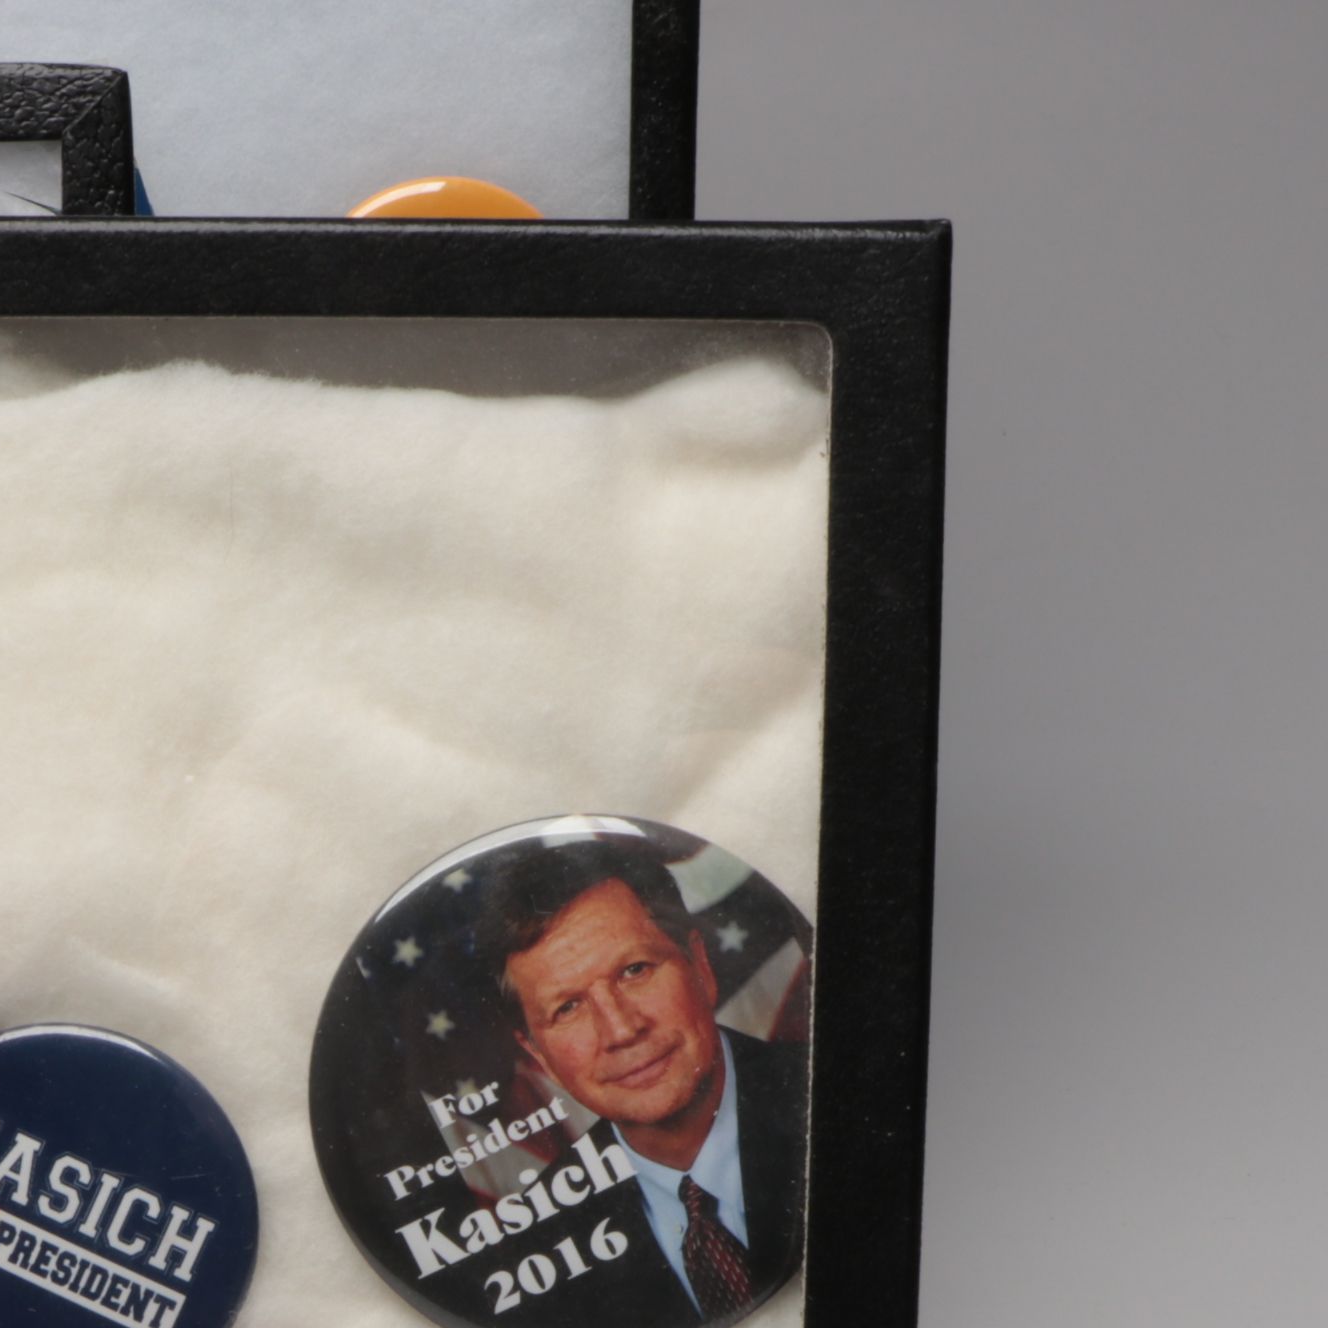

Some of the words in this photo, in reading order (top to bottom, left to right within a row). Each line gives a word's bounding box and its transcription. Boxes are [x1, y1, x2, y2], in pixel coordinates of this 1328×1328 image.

[383, 1095, 570, 1200] President
[427, 1081, 500, 1128] For
[394, 1132, 639, 1279] Kasich
[483, 1217, 628, 1315] 2016
